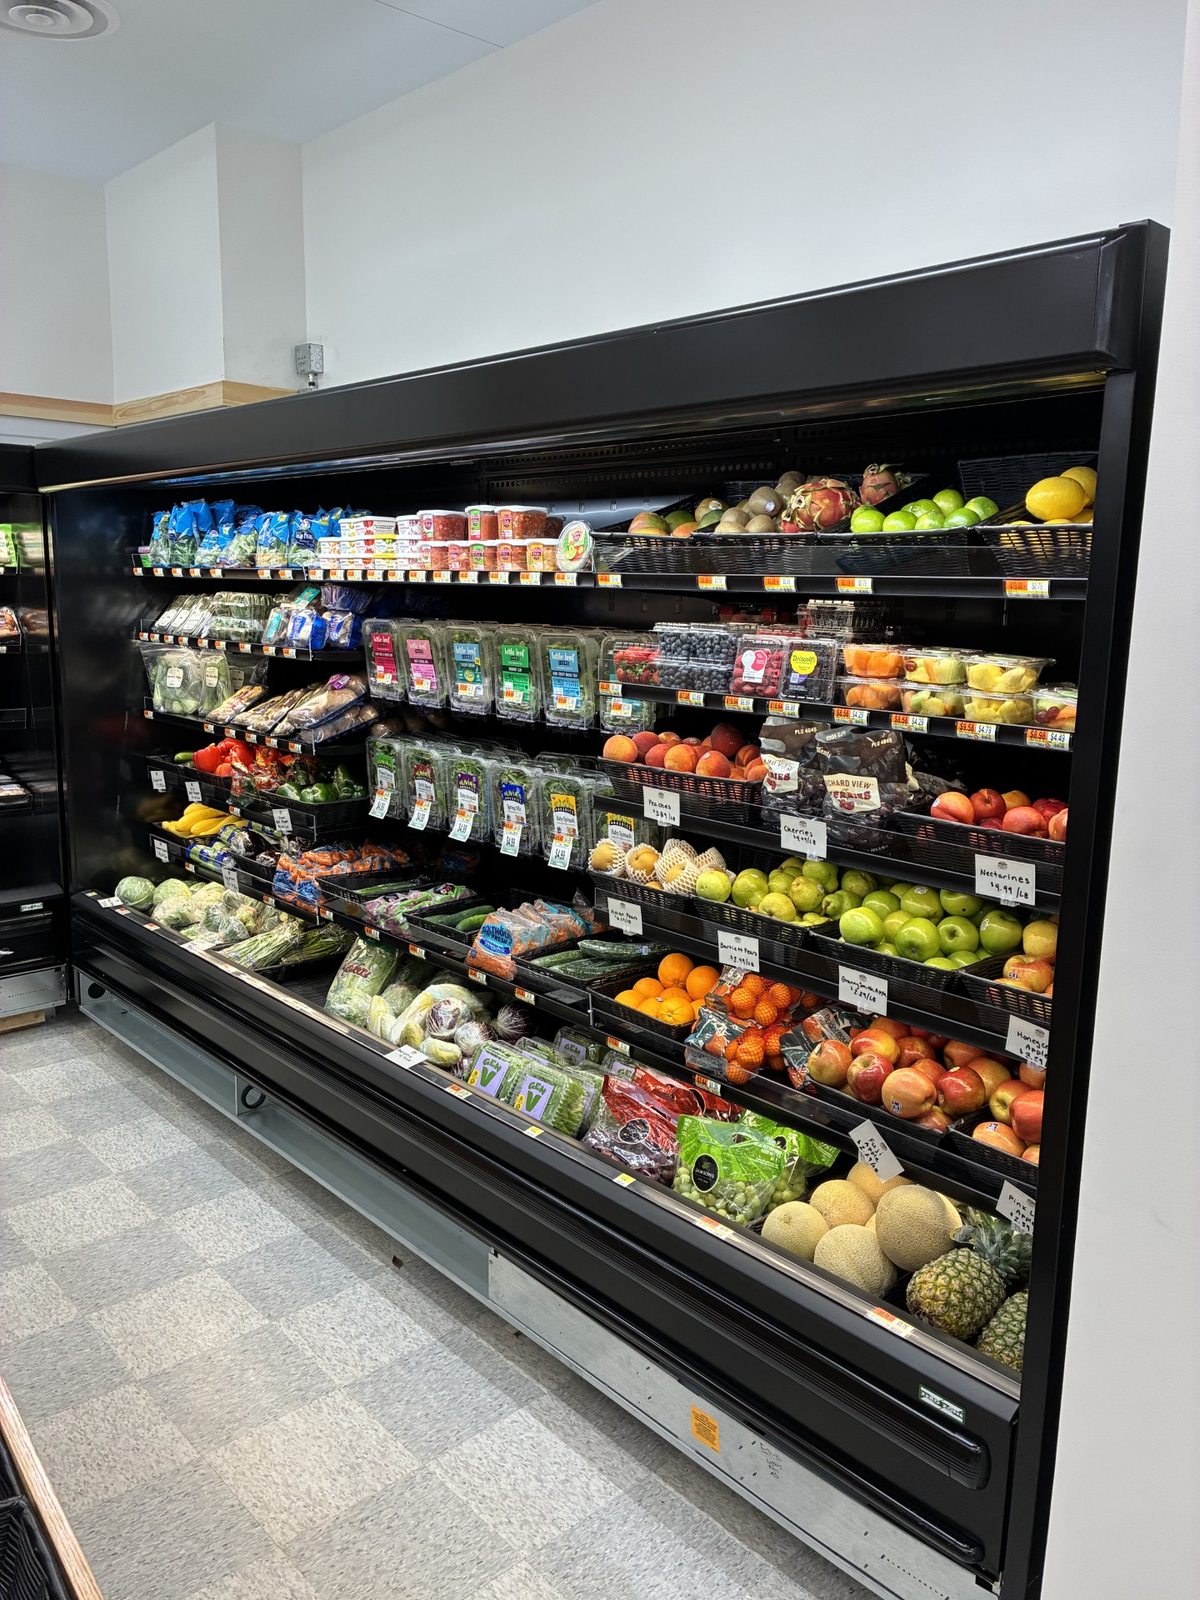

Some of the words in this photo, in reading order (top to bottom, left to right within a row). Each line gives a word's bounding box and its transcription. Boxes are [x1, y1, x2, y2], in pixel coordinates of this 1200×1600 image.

[792, 655, 815, 663] Driscoll's
[959, 722, 975, 731] $9.58
[977, 725, 992, 734] $4.79
[1049, 733, 1065, 742] $4.49
[851, 780, 871, 789] VIEW
[783, 825, 813, 837] Cherries
[980, 869, 1030, 884] Nectarines
[868, 1137, 884, 1157] Fuji
[1008, 1194, 1027, 1211] Pink
